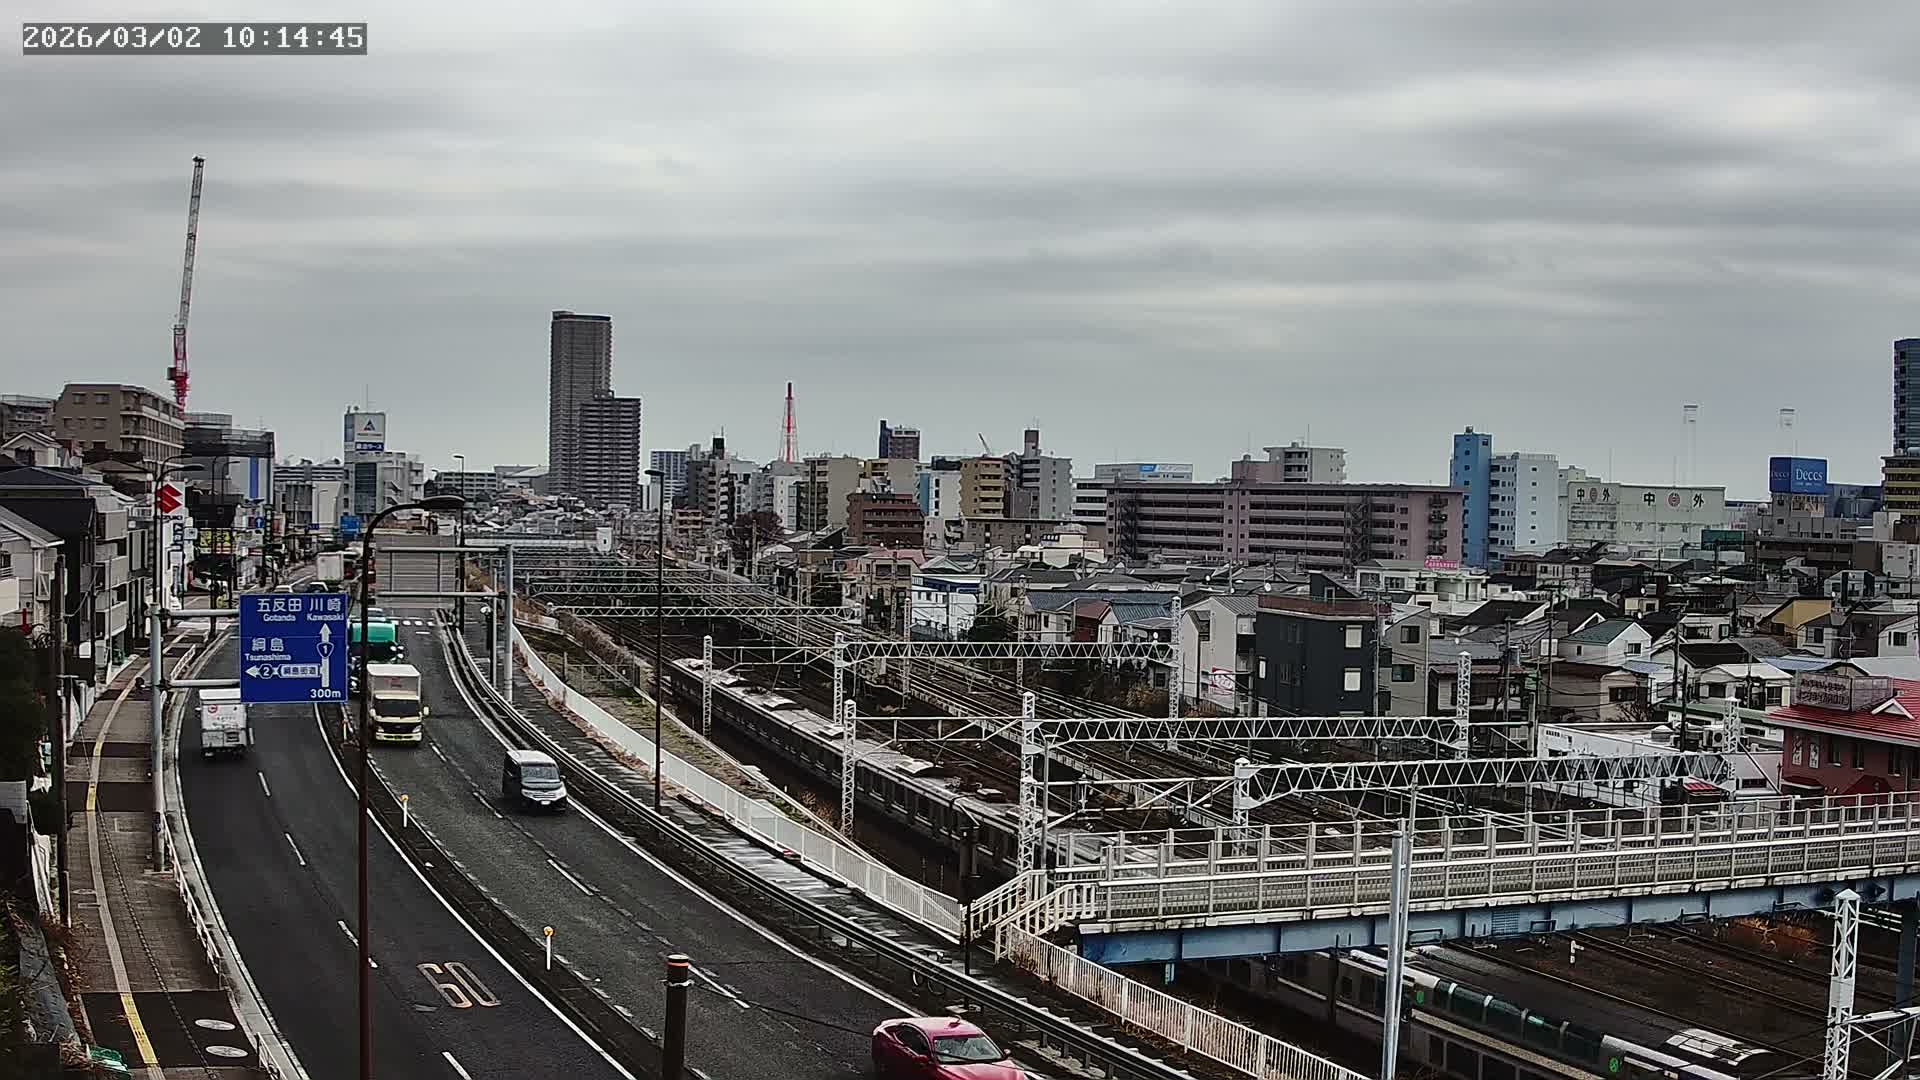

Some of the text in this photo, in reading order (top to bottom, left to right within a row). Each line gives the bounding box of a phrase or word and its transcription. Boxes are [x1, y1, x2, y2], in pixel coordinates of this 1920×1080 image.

[1796, 468, 1824, 481] Deccs
[1643, 491, 1705, 508] 中 外
[256, 598, 341, 612] 五反田 川崎
[263, 613, 344, 622] Gotanda Kawasaki
[322, 645, 328, 654] 1
[244, 653, 292, 661] Tsunashima
[262, 666, 271, 676] 2
[310, 688, 341, 698] 300m
[416, 962, 501, 1007] 60
